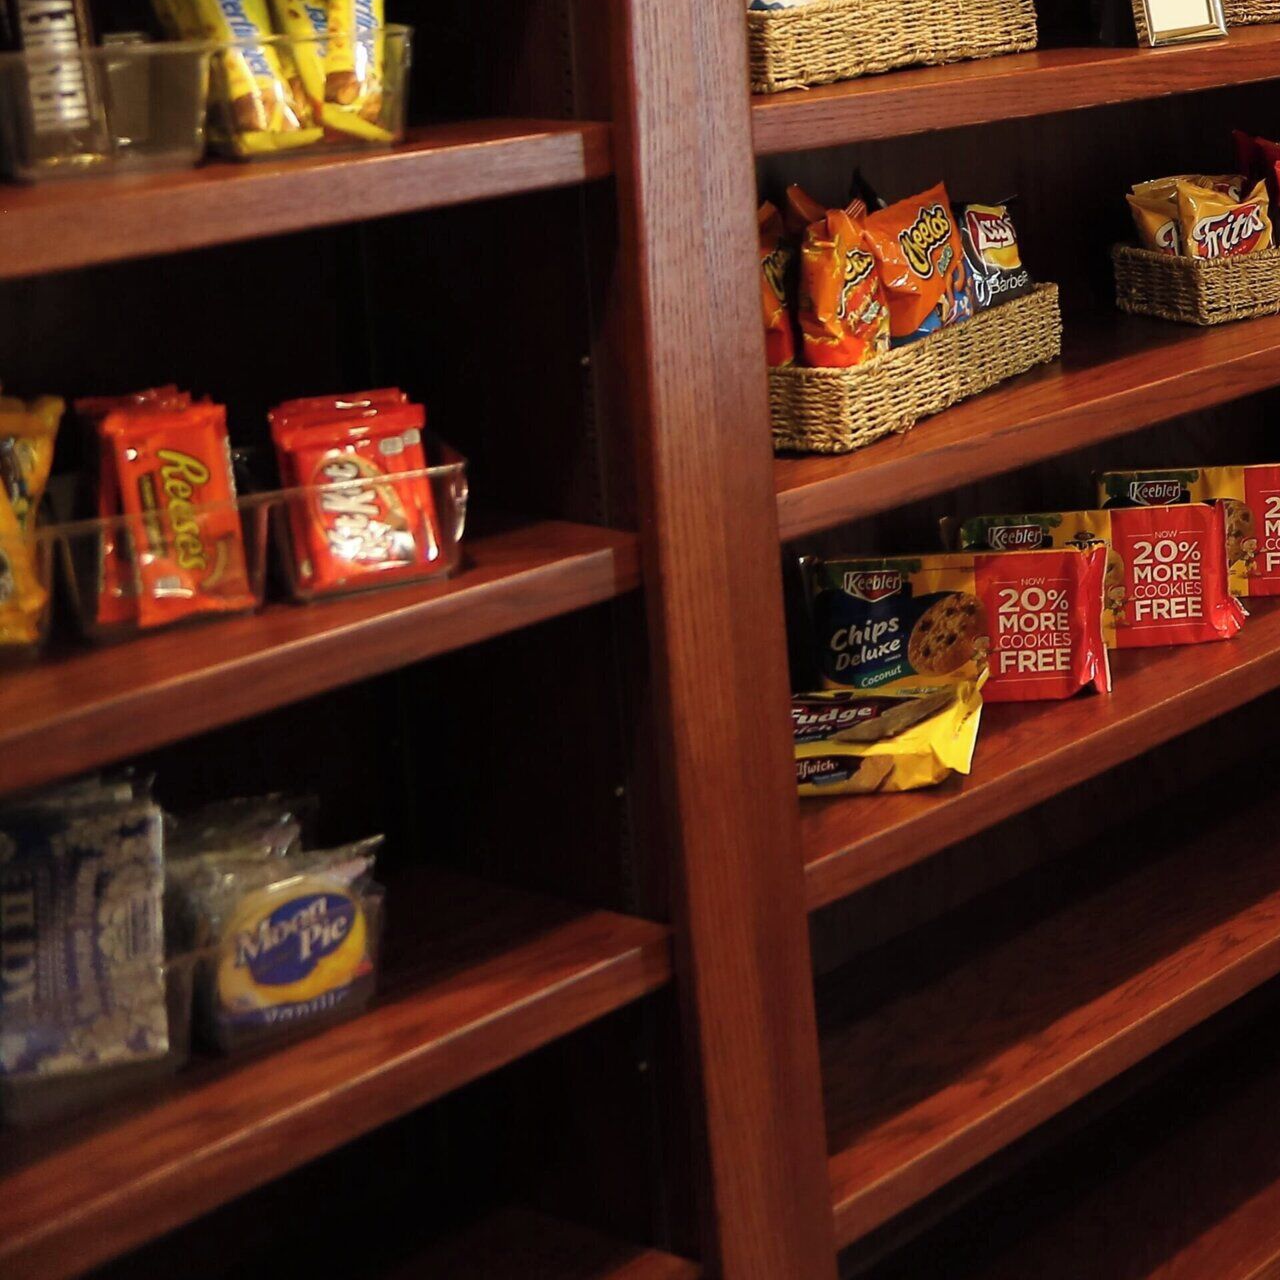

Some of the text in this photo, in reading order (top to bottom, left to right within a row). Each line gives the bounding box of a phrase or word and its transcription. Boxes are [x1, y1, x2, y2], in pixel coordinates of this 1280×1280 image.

[1194, 204, 1264, 258] Fritos
[1132, 481, 1180, 499] Keebler
[992, 527, 1041, 546] Keebler
[1155, 531, 1178, 539] NOW
[1133, 540, 1201, 564] 20%
[846, 572, 901, 593] Keebler
[1021, 577, 1045, 586] NOW
[1133, 565, 1201, 584] MORE
[998, 587, 1069, 613] 20%
[1134, 582, 1202, 598] COOKIES
[1134, 597, 1203, 622] FREE
[831, 616, 900, 651] Chips
[999, 613, 1070, 633] MORE
[1000, 632, 1072, 648] COOKIES
[835, 638, 901, 671] Deluxe
[1000, 648, 1072, 674] FREE
[861, 666, 902, 688] Coconut
[791, 706, 872, 724] Fudge
[235, 897, 329, 968] Moon
